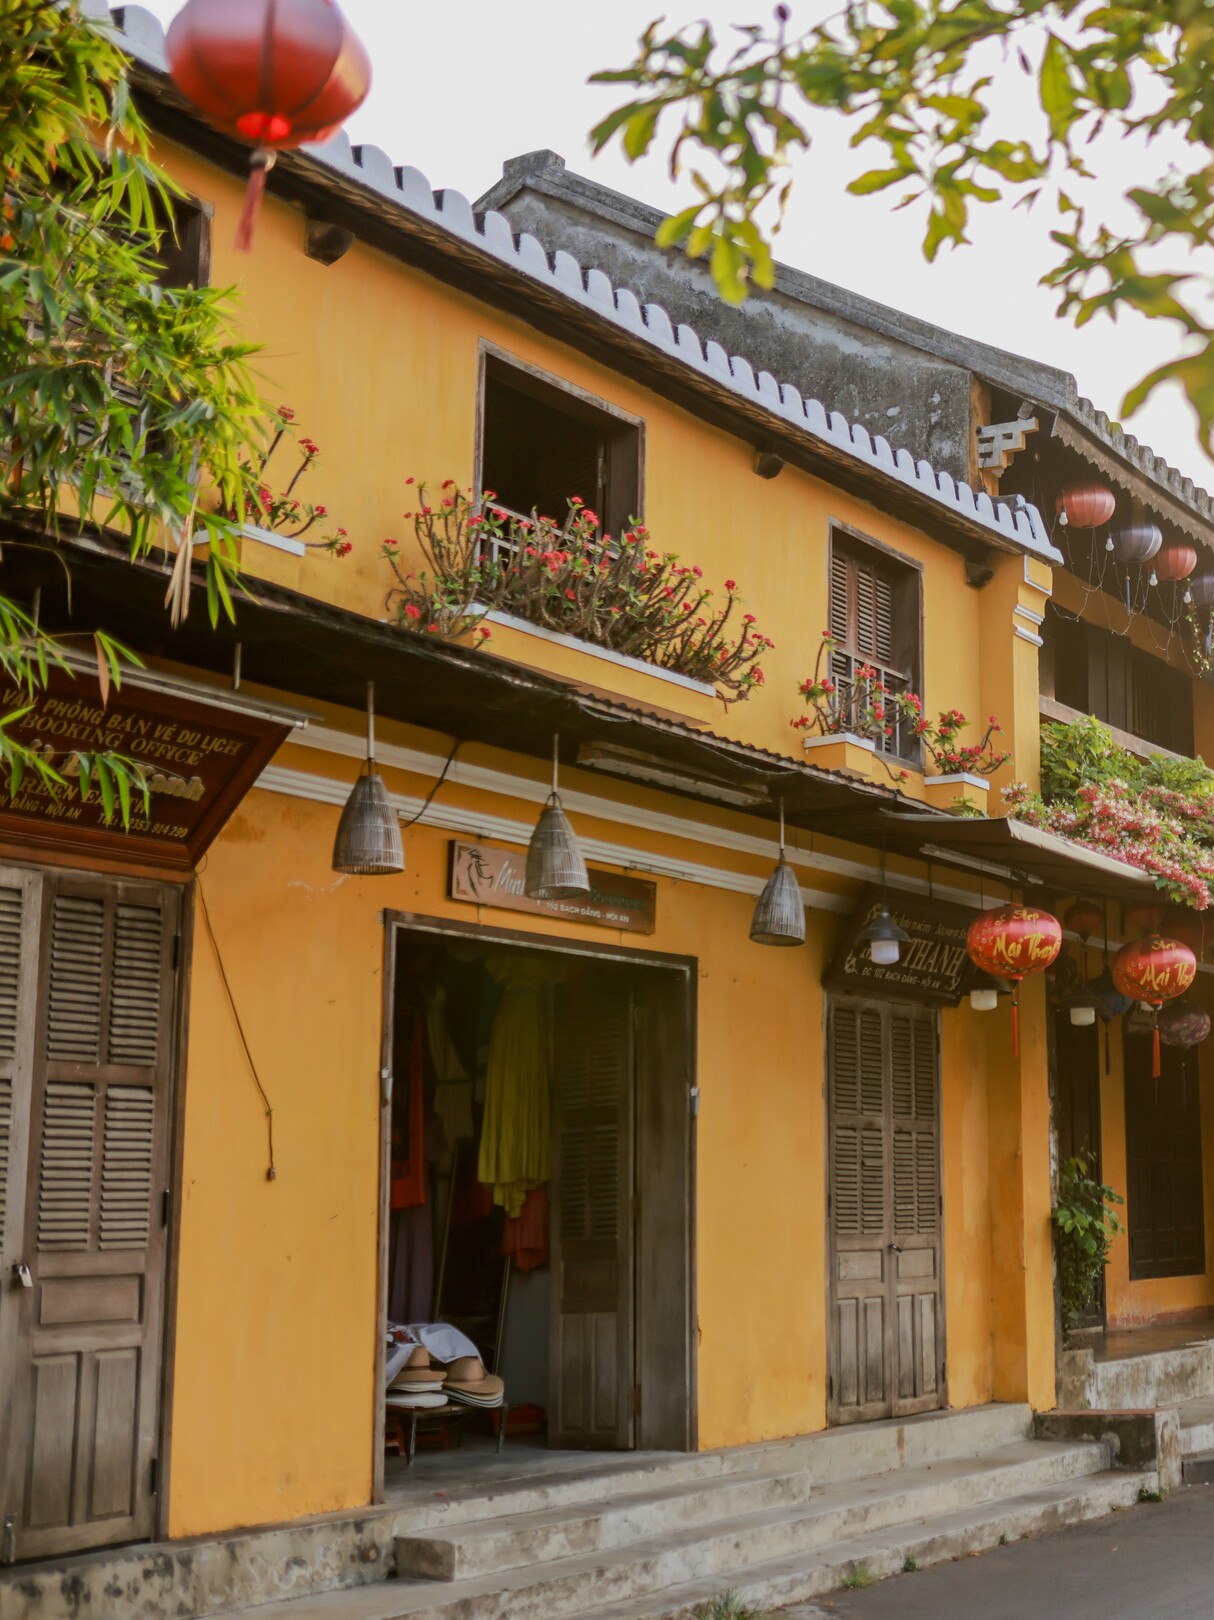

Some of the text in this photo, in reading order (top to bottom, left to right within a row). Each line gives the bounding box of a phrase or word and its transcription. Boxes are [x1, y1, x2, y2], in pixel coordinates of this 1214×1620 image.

[19, 712, 124, 748] BOOKING
[129, 737, 203, 765] OFFICE
[176, 729, 201, 746] DU
[64, 808, 82, 820] AN
[151, 822, 170, 837] 914
[618, 914, 631, 923] AN
[1012, 909, 1040, 931] Shop
[901, 937, 968, 977] THANH
[992, 931, 1024, 965] Mai
[1151, 940, 1177, 958] Shop
[873, 967, 885, 979] 102
[1139, 963, 1171, 991] Mai
